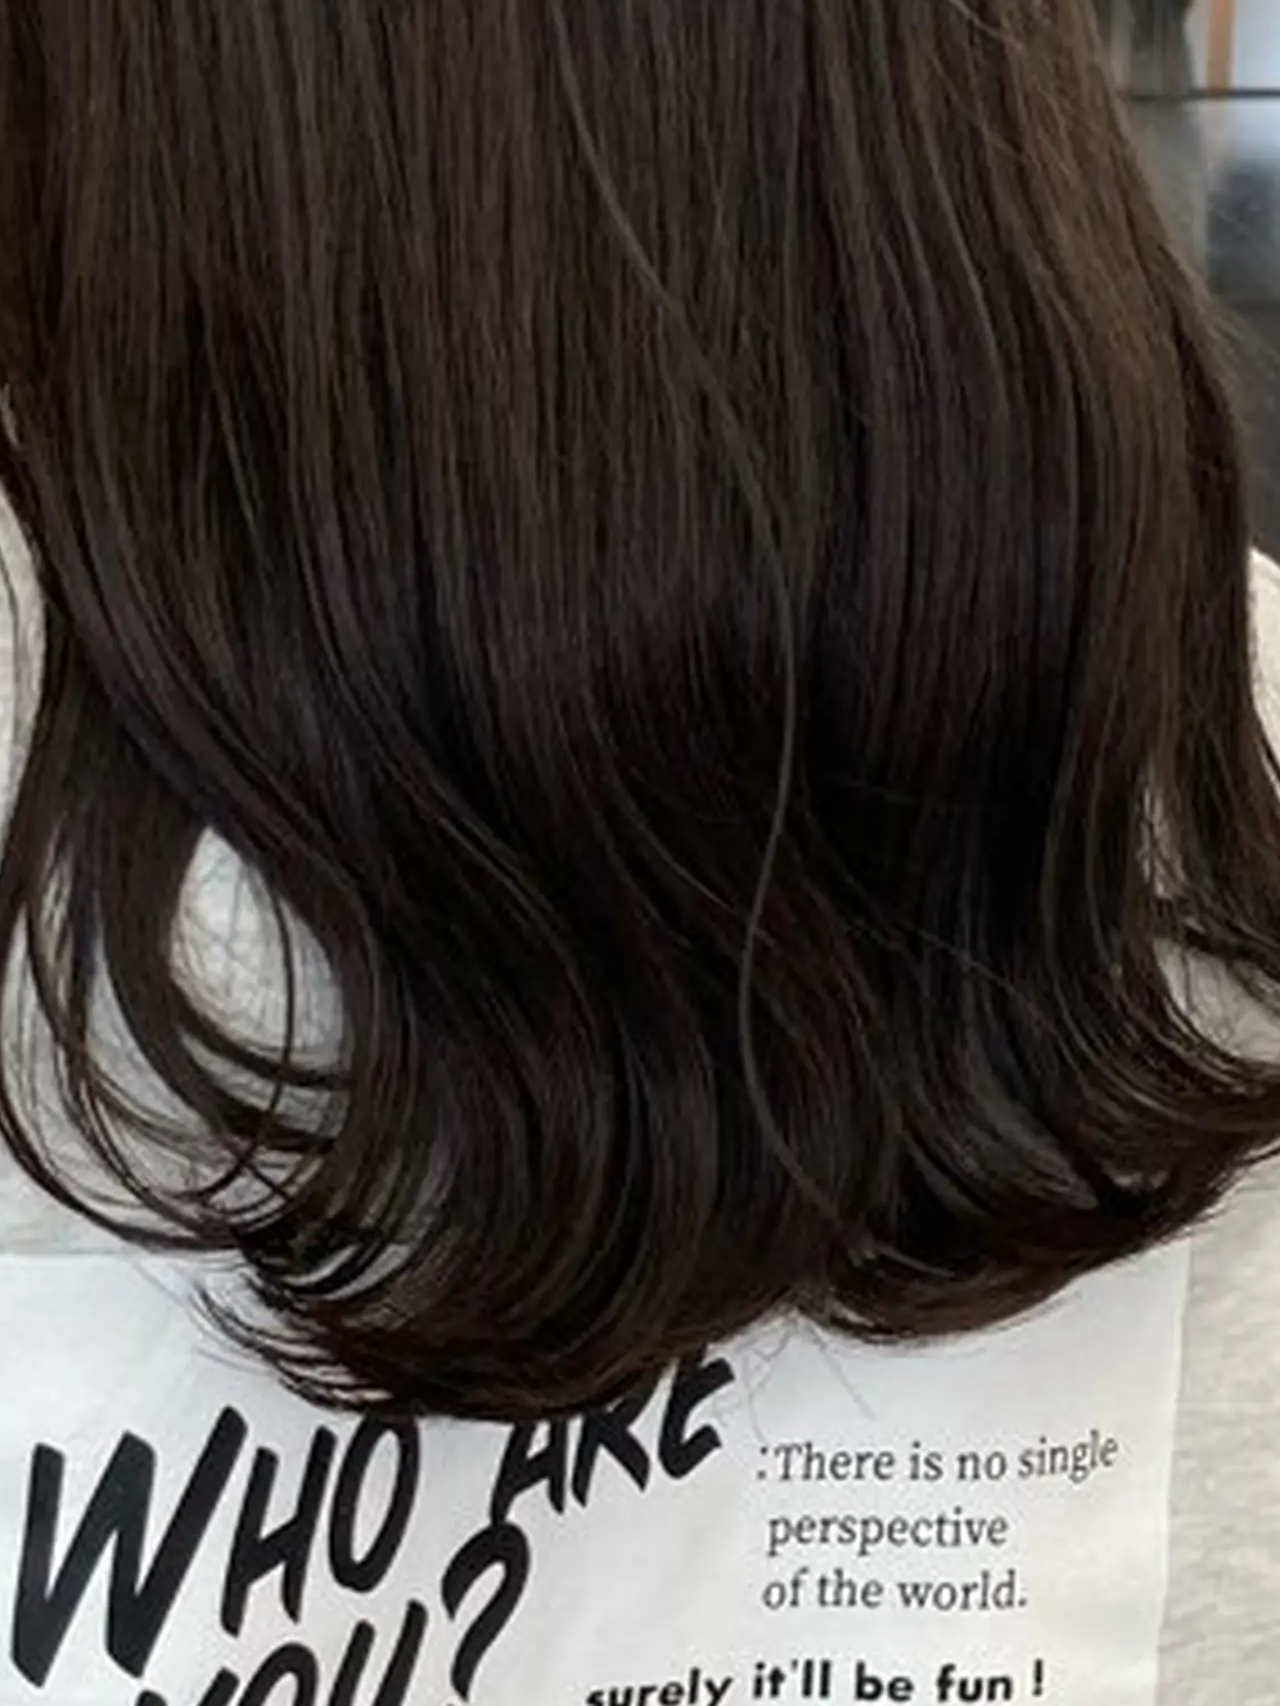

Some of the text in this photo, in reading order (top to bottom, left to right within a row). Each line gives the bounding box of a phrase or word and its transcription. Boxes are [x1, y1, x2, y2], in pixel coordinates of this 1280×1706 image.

[756, 1428, 1119, 1485] :There is no single
[9, 1341, 737, 1690] WHO ARE
[765, 1505, 1010, 1559] perspective
[761, 1565, 1028, 1612] of the world.
[751, 1657, 833, 1701] it'll
[853, 1659, 916, 1705] be
